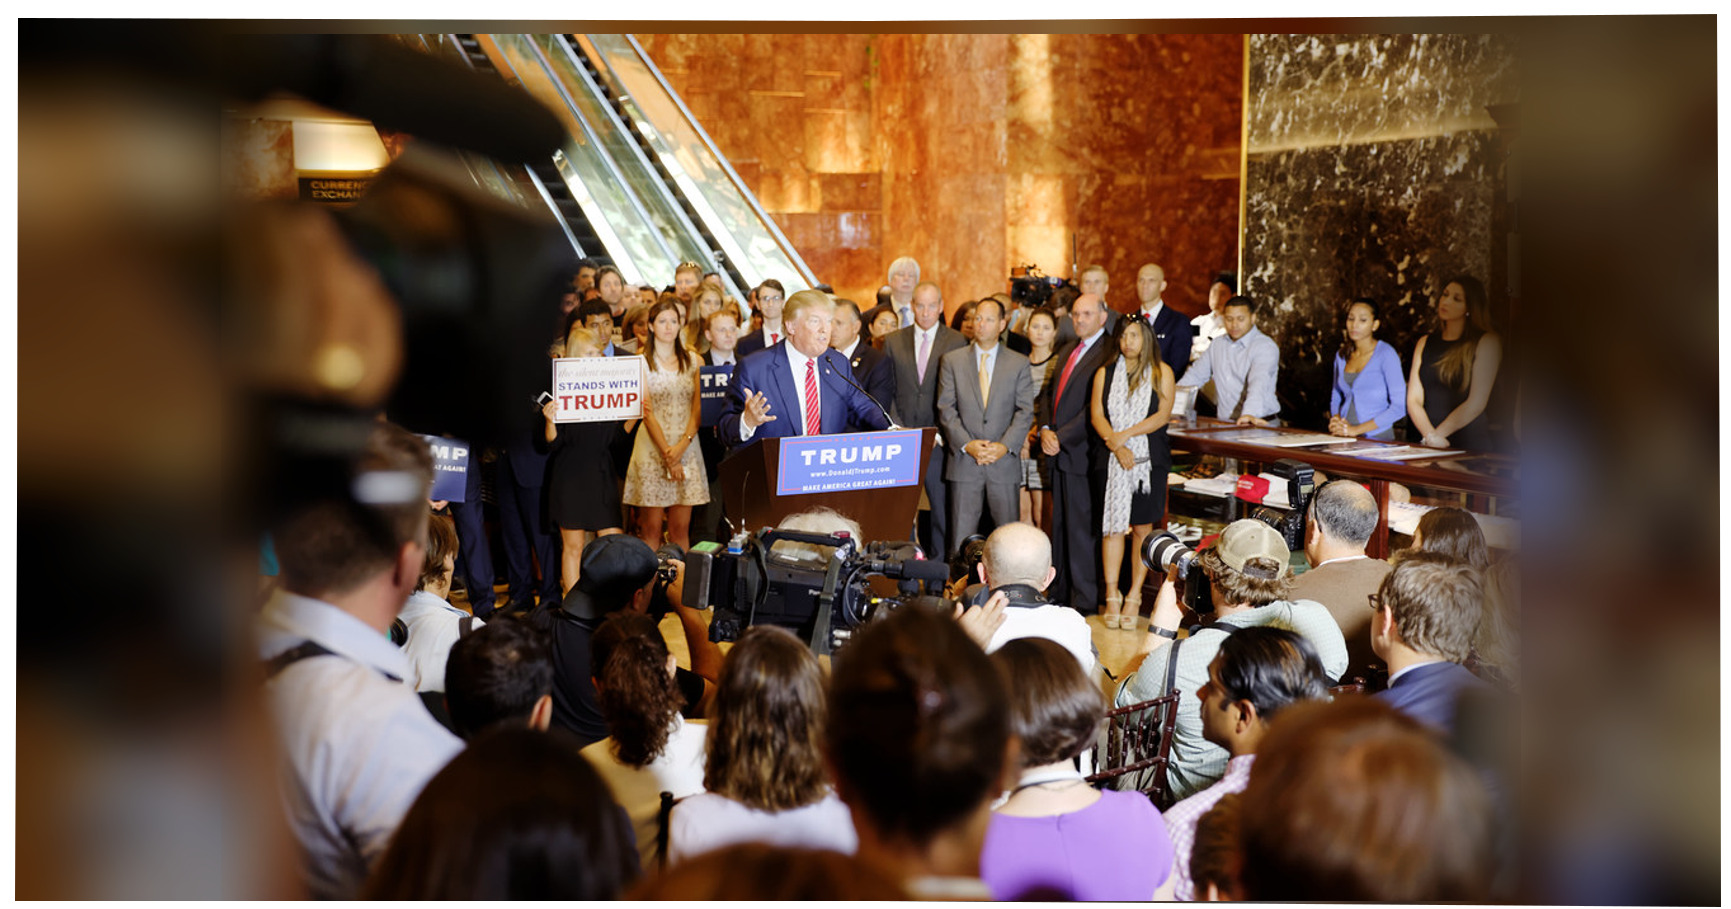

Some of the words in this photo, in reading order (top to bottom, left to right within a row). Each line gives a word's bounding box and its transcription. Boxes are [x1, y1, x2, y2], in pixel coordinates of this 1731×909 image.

[310, 180, 368, 190] CURRENC
[312, 190, 361, 199] EXCHAN
[558, 380, 606, 391] STANDS
[608, 379, 638, 389] WITH
[558, 392, 638, 411] TRUMP
[800, 443, 902, 466] TRUMP
[802, 484, 821, 492] MAKE
[821, 481, 852, 491] AMERICA
[852, 480, 872, 488] GREAT
[872, 478, 896, 487] AGAIN!
